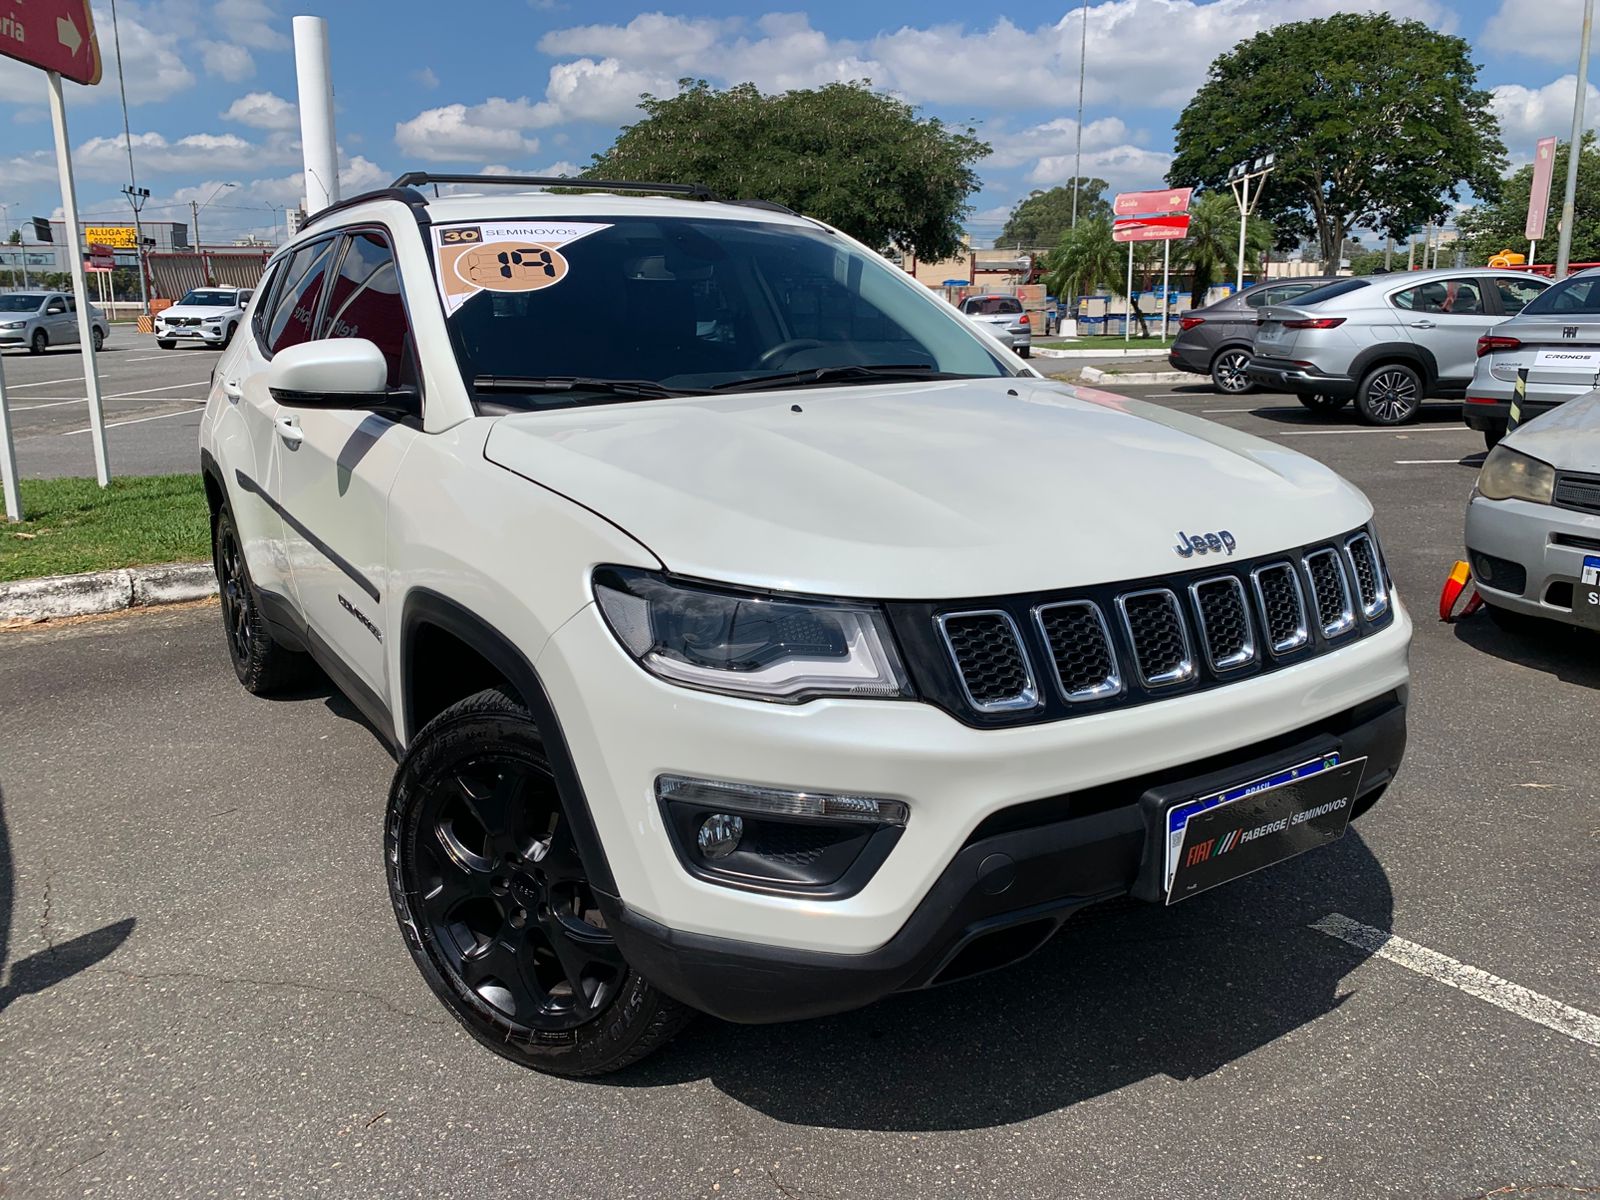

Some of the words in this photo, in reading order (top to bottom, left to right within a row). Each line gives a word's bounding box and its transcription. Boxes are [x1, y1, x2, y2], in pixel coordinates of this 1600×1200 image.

[0, 11, 25, 42] ria
[444, 230, 479, 242] 30
[485, 228, 577, 236] SEMINOVOS
[497, 248, 556, 278] 19
[1562, 326, 1580, 338] FIAT
[1172, 530, 1236, 558] Jeep
[1588, 591, 1600, 605] S
[1186, 839, 1215, 867] FIAT
